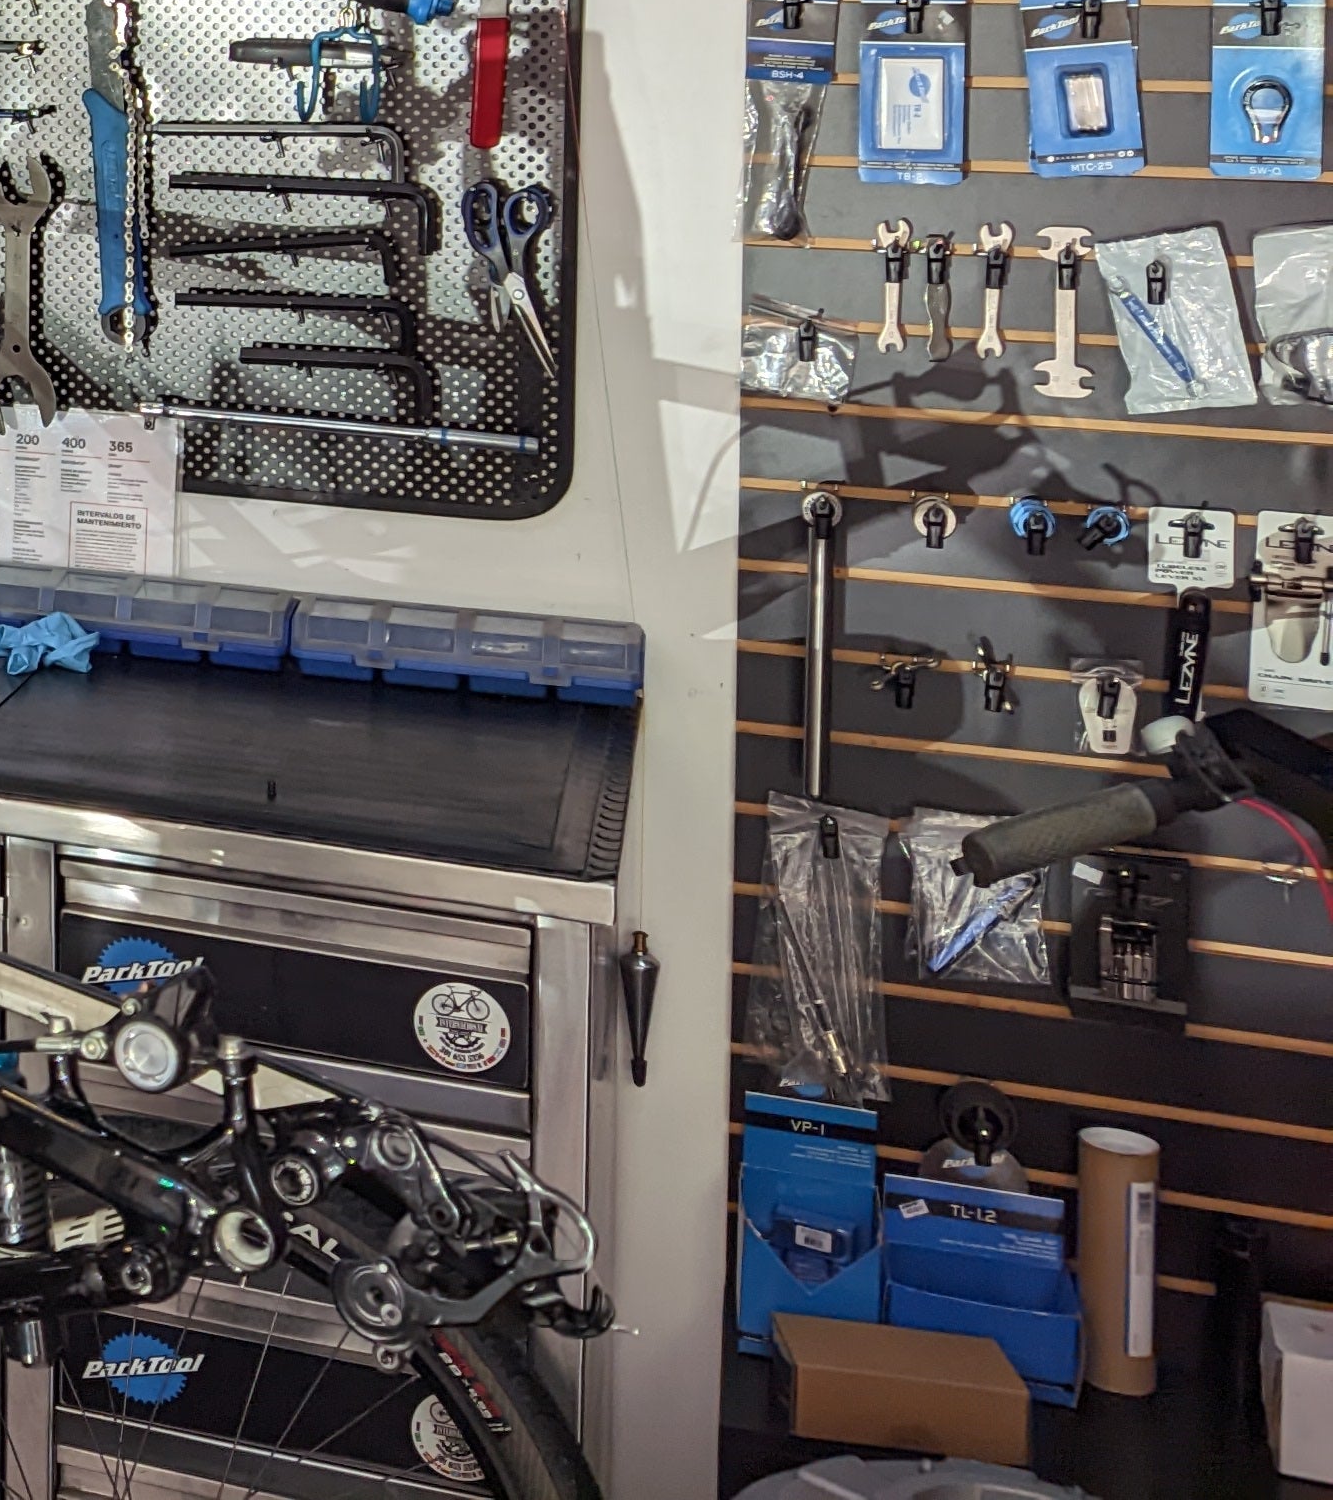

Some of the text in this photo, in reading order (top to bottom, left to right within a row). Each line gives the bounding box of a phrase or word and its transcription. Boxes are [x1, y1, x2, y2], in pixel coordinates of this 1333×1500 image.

[771, 70, 805, 80] BSH-4
[1070, 161, 1114, 172] MTC-25
[16, 434, 40, 446] 200
[61, 437, 86, 449] 400
[109, 441, 133, 453] 365
[125, 512, 136, 521] DE
[1155, 533, 1230, 549] LENE
[1175, 631, 1199, 705] LEZYNE
[790, 1119, 825, 1136] VP-1
[82, 1352, 204, 1381] ParkTool
